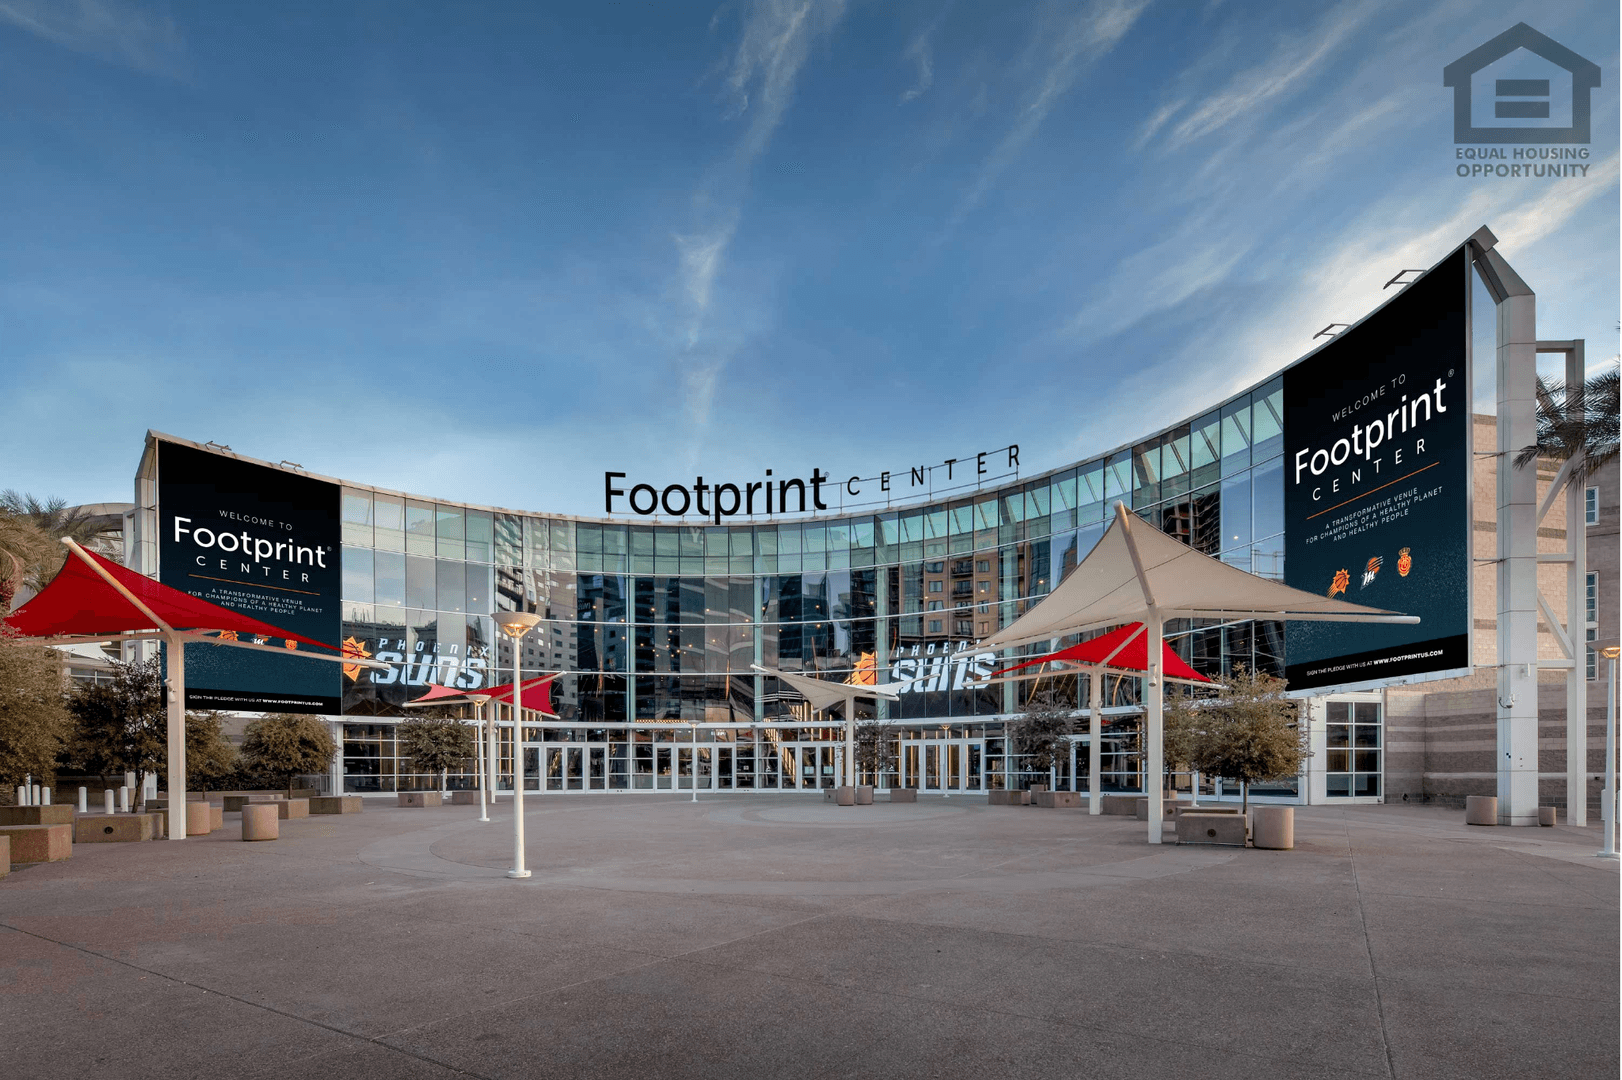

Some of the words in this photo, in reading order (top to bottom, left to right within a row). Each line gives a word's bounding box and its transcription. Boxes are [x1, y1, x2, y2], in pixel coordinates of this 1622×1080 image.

[1332, 385, 1386, 422] WELCOME
[1391, 374, 1406, 388] TO
[1295, 378, 1447, 485] Footprint
[1312, 438, 1425, 501] CENTER
[604, 468, 828, 526] Footprint
[847, 444, 1020, 496] CENTER
[219, 509, 274, 527] WELCOME
[279, 522, 293, 531] TO
[1306, 535, 1318, 544] FOR
[1320, 520, 1358, 540] CHAMPIONS
[1361, 516, 1369, 524] OF
[1380, 498, 1411, 518] HEALTHY
[1414, 486, 1443, 504] PLANET
[1332, 498, 1391, 526] TRANSFORMATIVE
[1394, 487, 1418, 504] VENUE
[1333, 532, 1346, 542] AND
[1349, 520, 1378, 536] HEALTHY
[1382, 508, 1409, 524] PEOPLE
[174, 516, 326, 568] Footprint
[196, 556, 309, 582] CENTER
[206, 593, 248, 604] CHAMPIONS
[268, 602, 297, 610] HEALTHY
[300, 606, 322, 614] PLANET
[220, 589, 280, 602] TRANSFORMATIVE
[238, 603, 268, 612] HEALTHY
[378, 638, 490, 657] PHOENIX
[896, 639, 996, 658] PHOEN
[1328, 665, 1346, 673] PLEDGE
[1374, 650, 1444, 666] WWW.FOOTPRINTUS.COM
